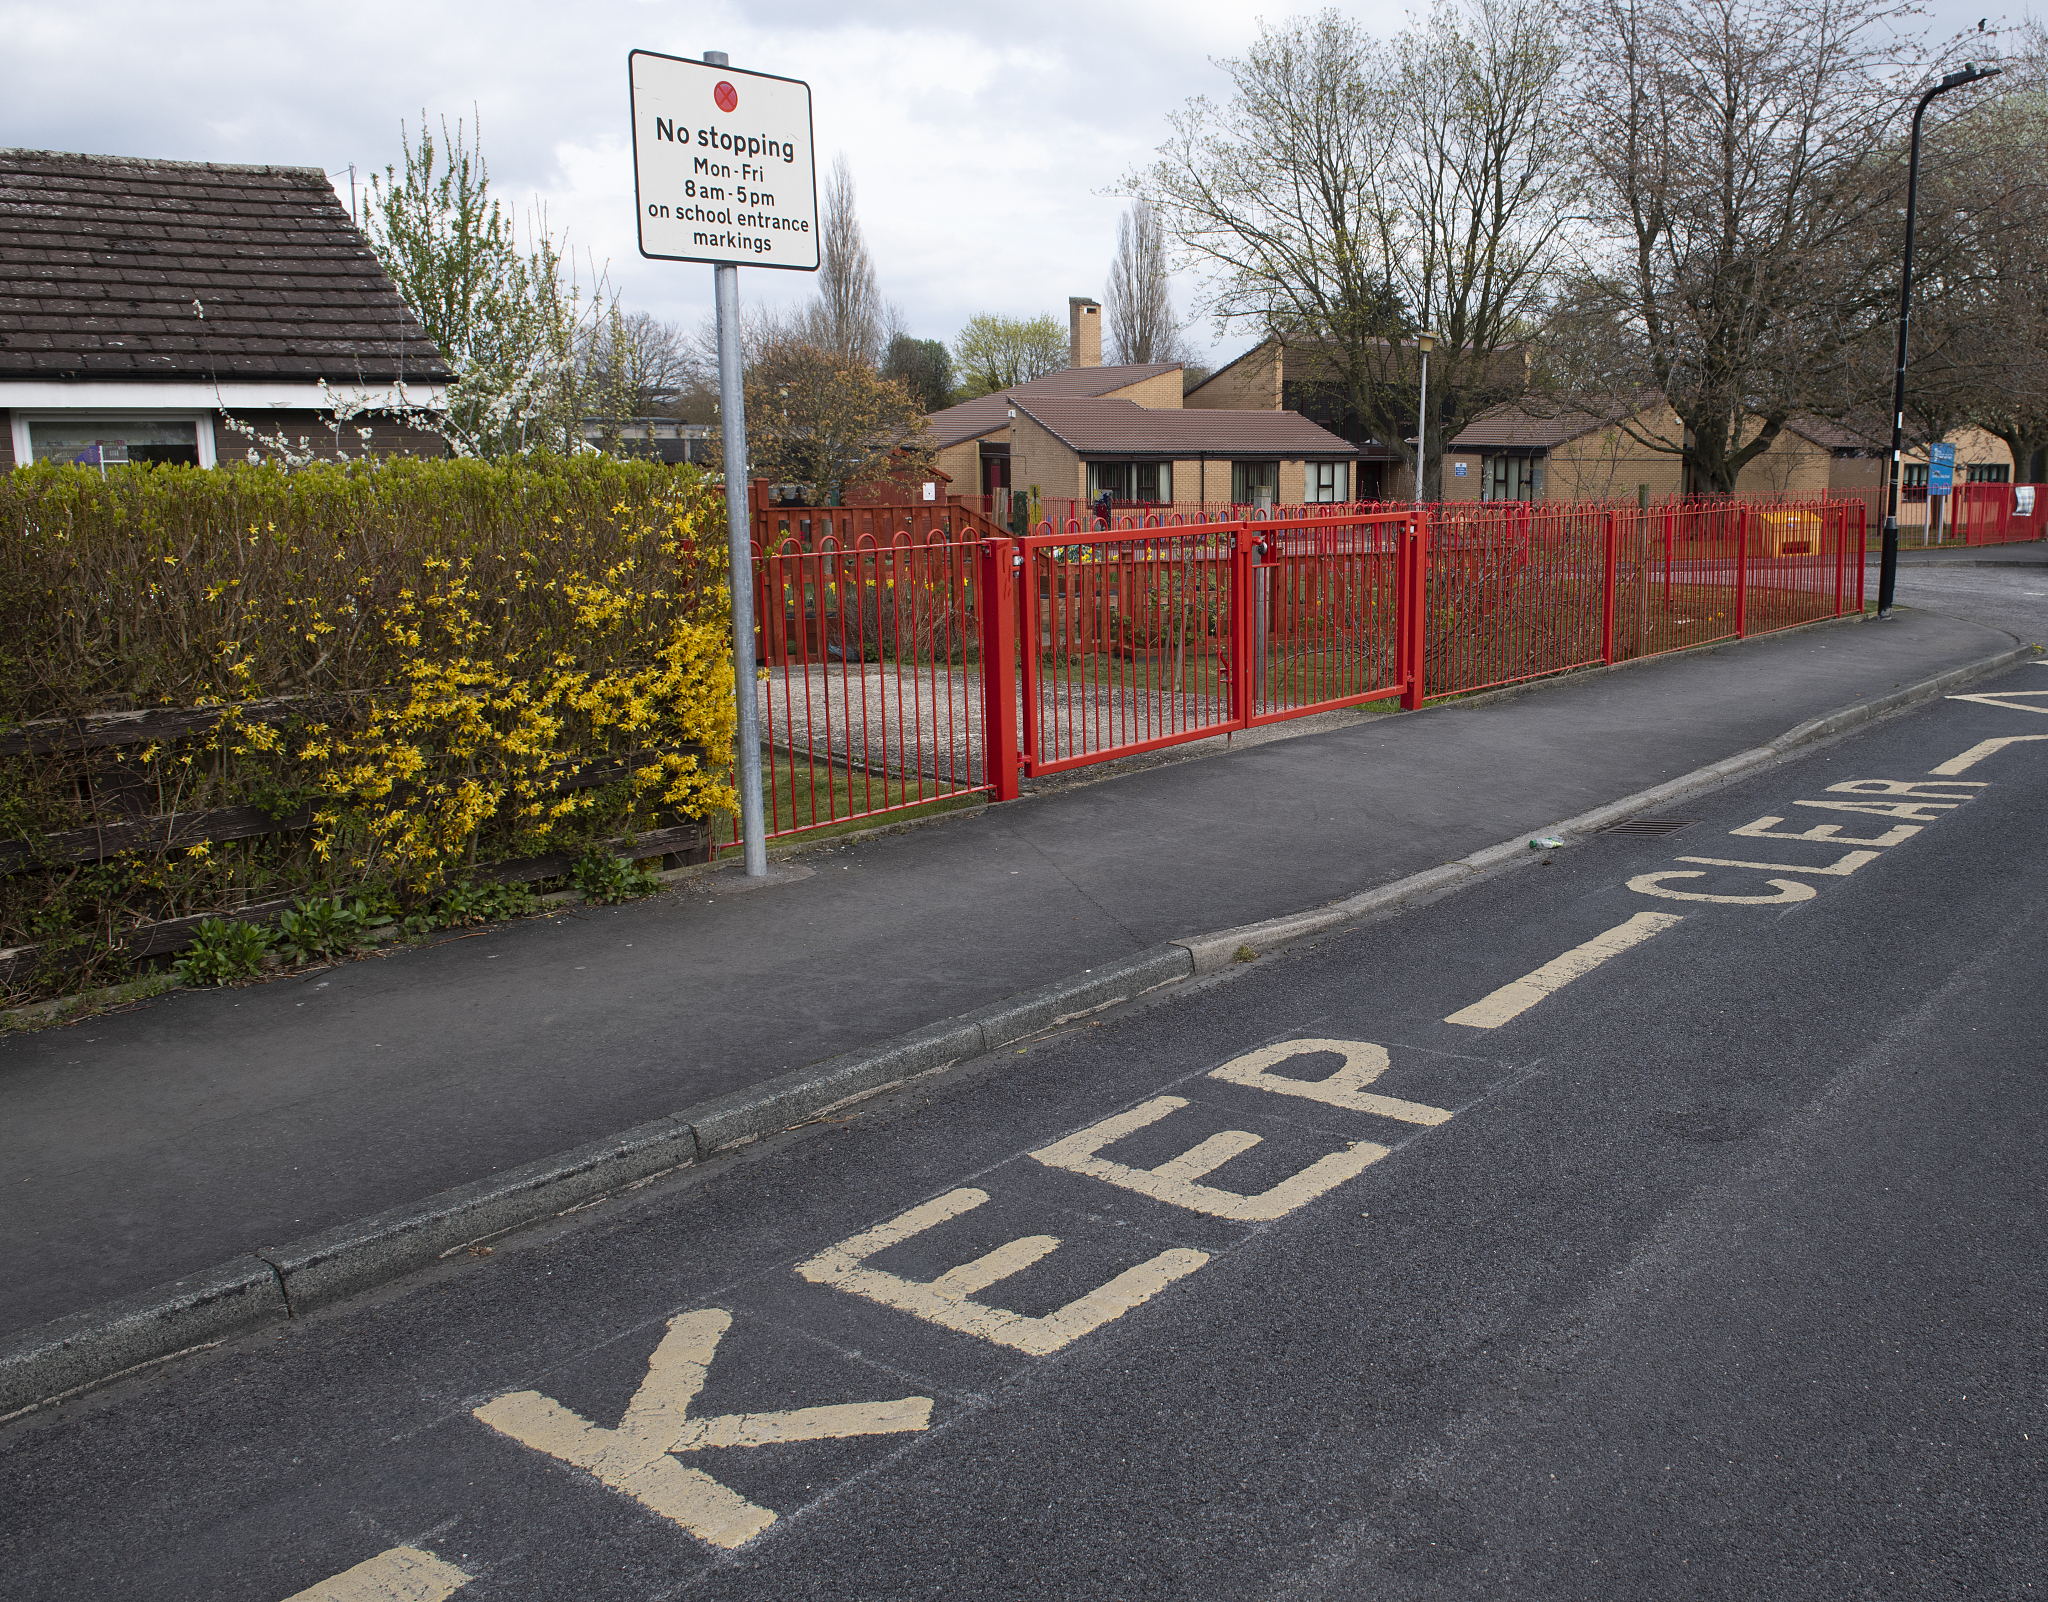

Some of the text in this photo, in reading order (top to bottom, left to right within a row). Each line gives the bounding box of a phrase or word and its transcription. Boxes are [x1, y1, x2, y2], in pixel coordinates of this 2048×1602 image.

[656, 116, 794, 164] No stopping
[648, 203, 809, 233] on school entrance
[693, 230, 772, 254] markings
[472, 778, 1990, 1550] KEEP CLEAR
